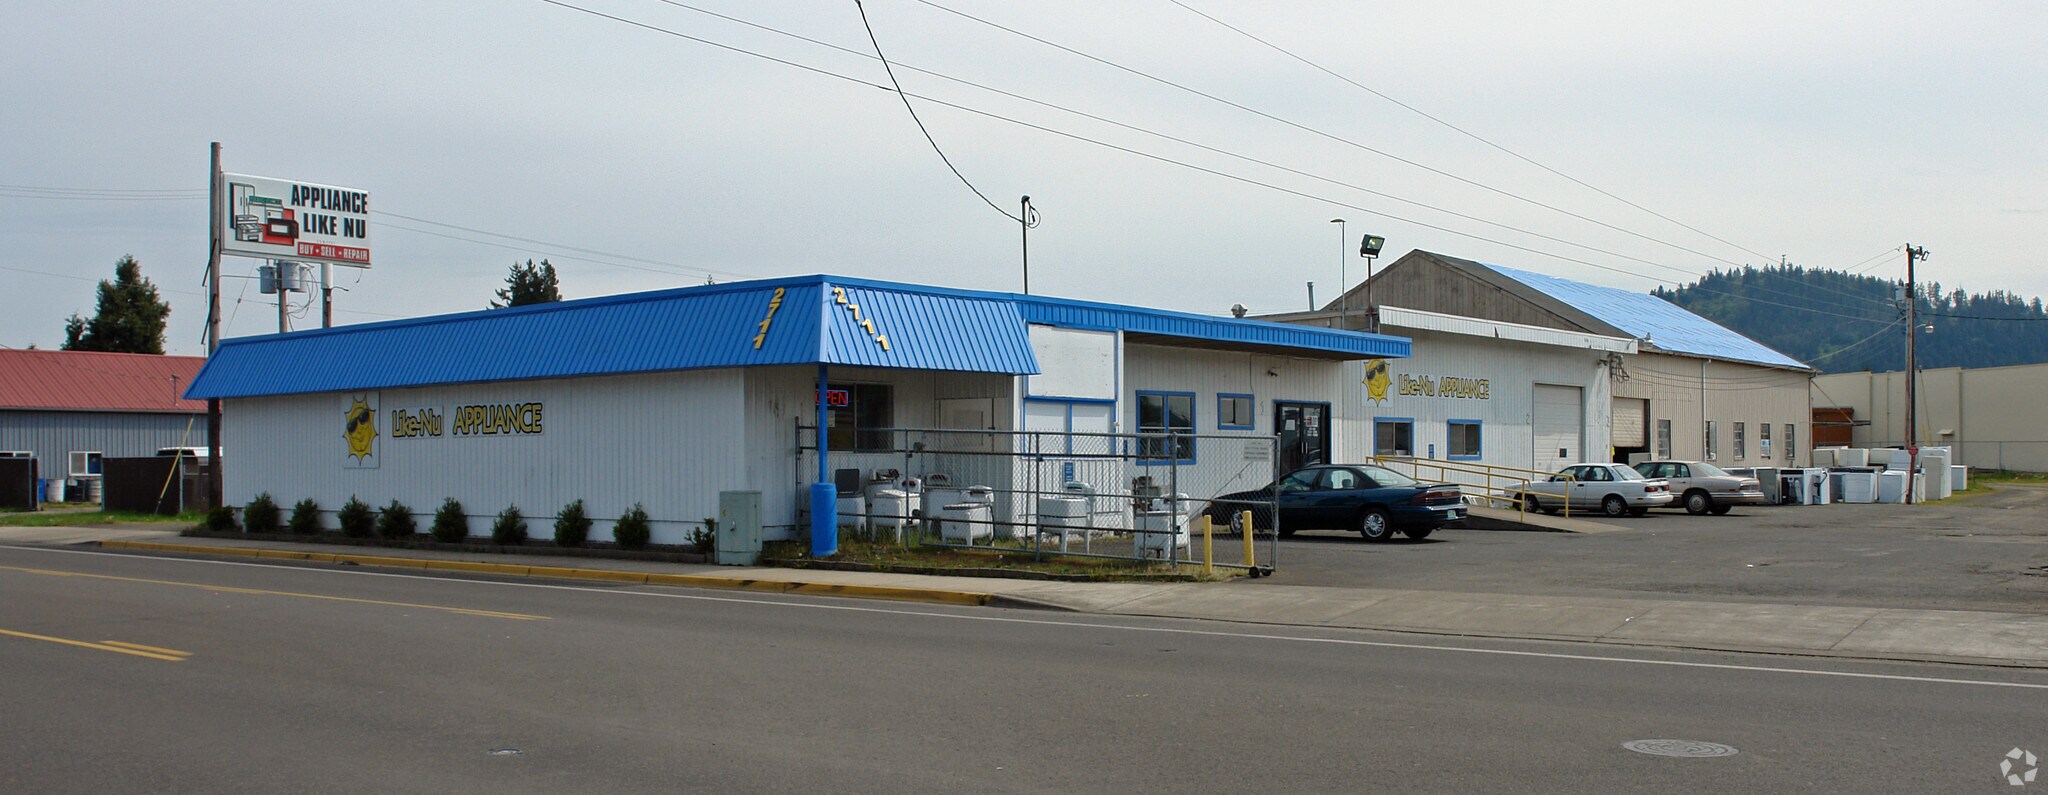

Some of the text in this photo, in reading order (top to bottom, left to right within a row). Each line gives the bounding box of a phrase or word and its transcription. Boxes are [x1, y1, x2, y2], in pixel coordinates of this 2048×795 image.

[291, 184, 368, 214] APPLIANCE
[303, 213, 366, 239] LIKE NU
[299, 243, 368, 260] BUY SELL REPAIR
[753, 287, 785, 349] 2711
[833, 287, 890, 351] 2711
[1399, 374, 1490, 400] Like-Nu APPLIANCE
[391, 402, 543, 438] Like-Nu APPLIANCE
